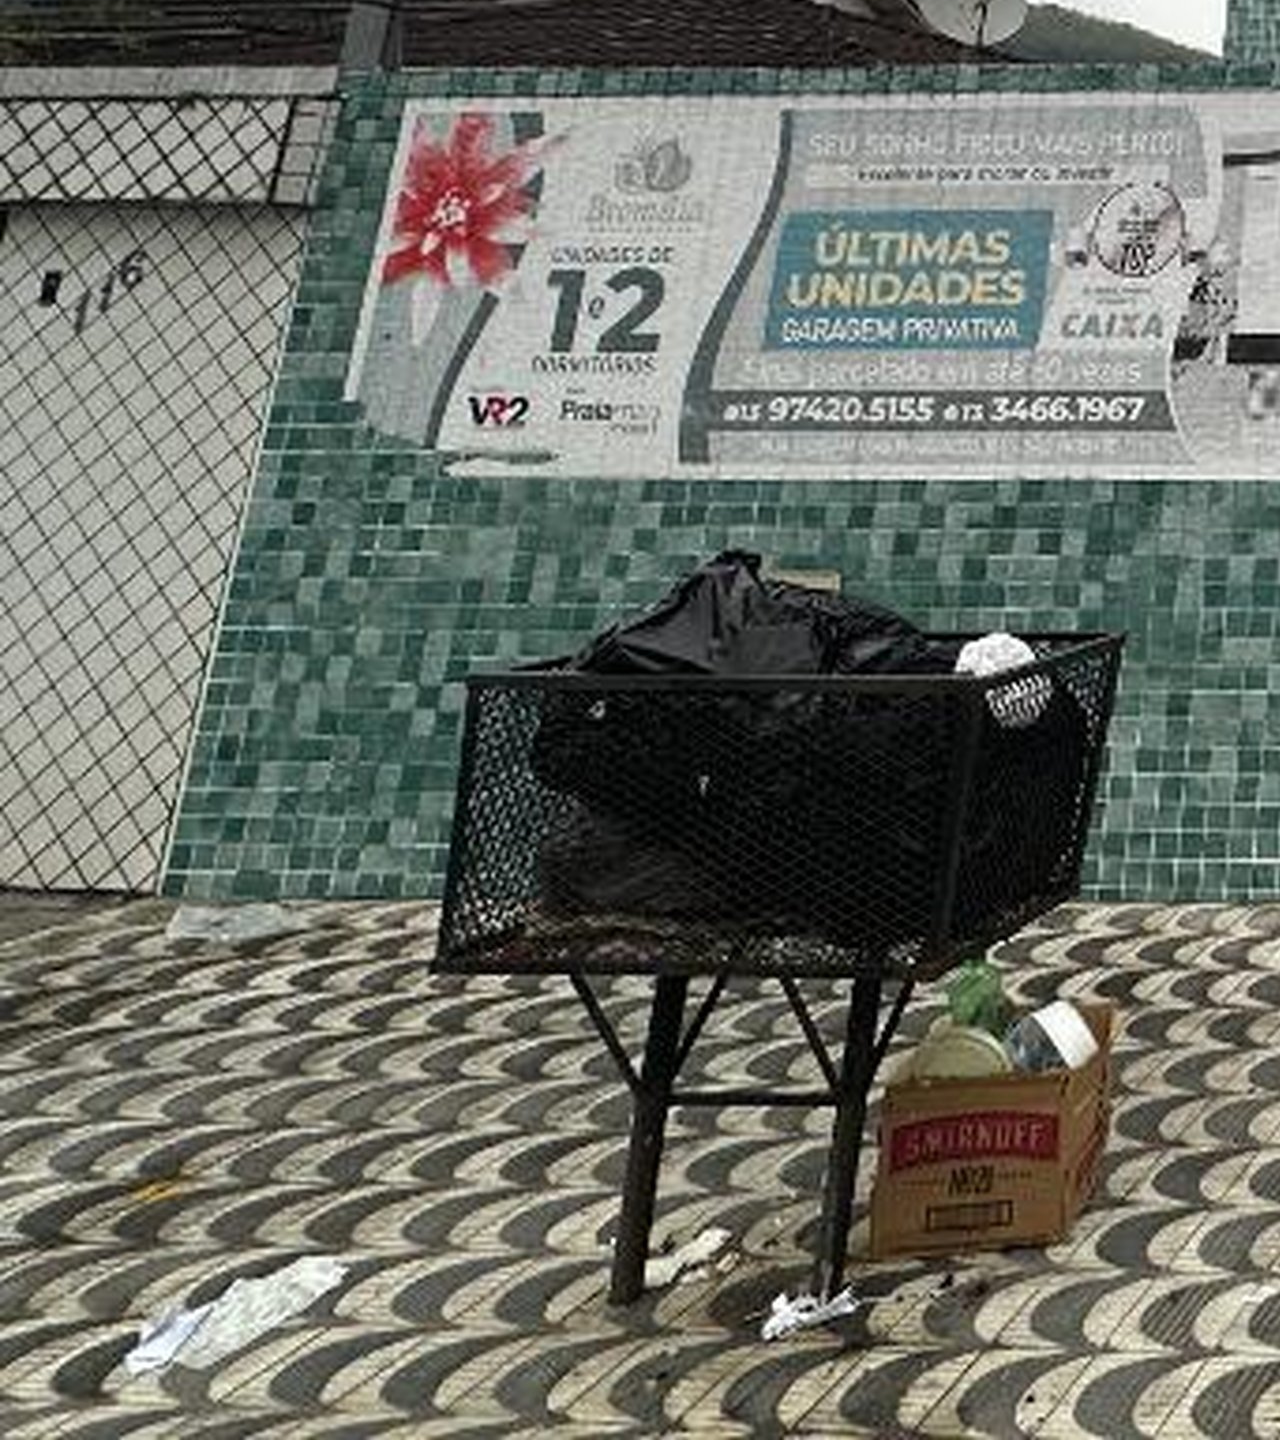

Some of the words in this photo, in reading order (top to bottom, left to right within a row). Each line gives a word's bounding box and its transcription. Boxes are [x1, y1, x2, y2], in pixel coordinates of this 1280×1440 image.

[648, 246, 675, 263] DE
[816, 219, 1011, 266] ÚLTIMAS
[787, 268, 1026, 309] UNIDADES
[547, 269, 586, 353] 1
[588, 296, 606, 320] e
[595, 265, 665, 353] 2
[781, 317, 896, 342] GARAGEM
[903, 317, 1020, 341] PRIVATIVA
[1061, 313, 1165, 339] CAIXA
[467, 395, 530, 427] VR2
[767, 396, 936, 422] 97420.5155
[903, 1116, 1046, 1158] SMIRNOFF
